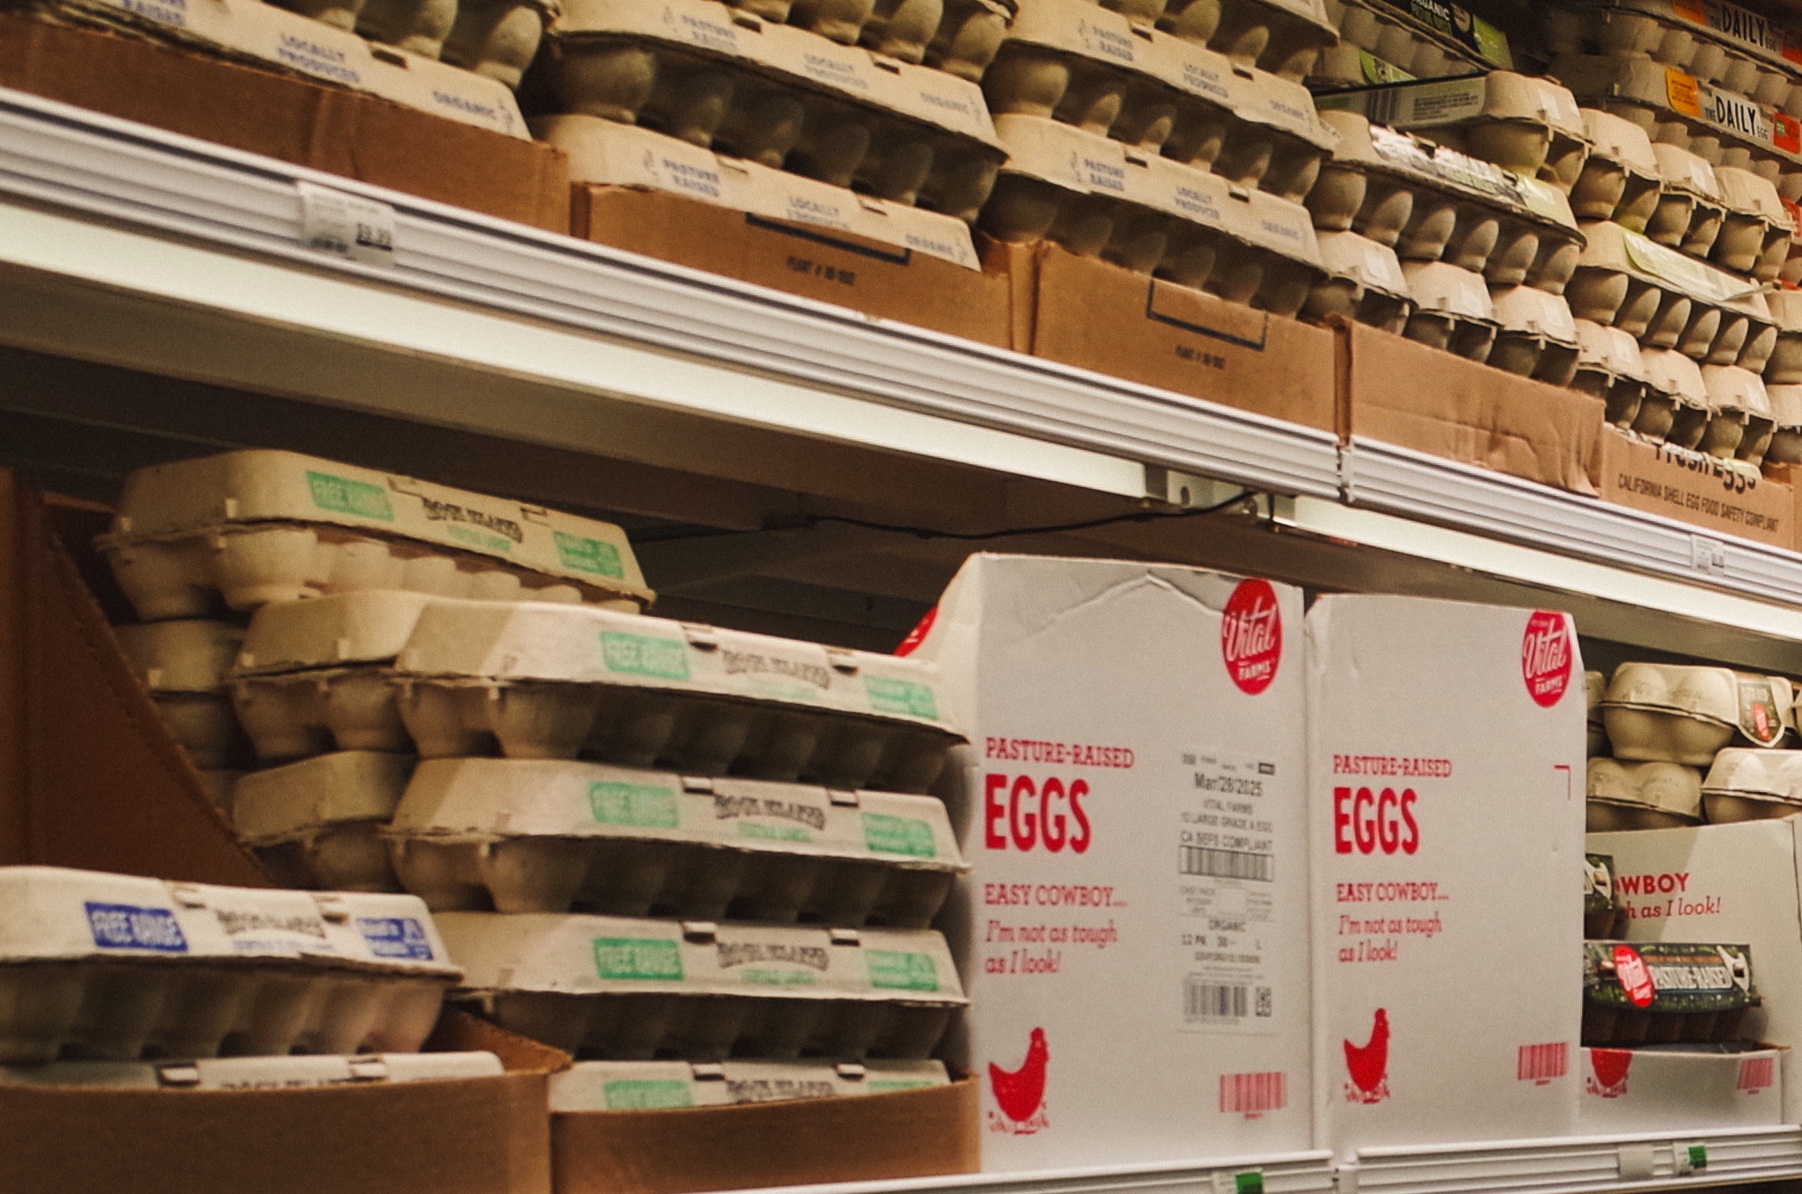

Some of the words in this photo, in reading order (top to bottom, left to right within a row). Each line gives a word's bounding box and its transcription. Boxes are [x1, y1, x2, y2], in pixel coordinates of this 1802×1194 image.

[1722, 4, 1766, 47] DAILY
[1705, 107, 1716, 122] THE
[1715, 95, 1756, 136] DAILY
[1618, 472, 1661, 498] CALIFORNIA
[1663, 485, 1685, 507] SHELL
[1686, 492, 1699, 511] EGG
[1701, 497, 1719, 517] FOOD
[1720, 503, 1744, 522] SAFETY
[1745, 510, 1779, 533] COMPLIANT
[1225, 597, 1276, 661] Vital
[1526, 620, 1568, 680] Vital
[1535, 676, 1563, 697] FARMS
[985, 736, 1135, 769] PASTURE-RAISED
[1333, 755, 1451, 778] PASTURE-RAISED
[984, 773, 1090, 854] EGGS
[1333, 786, 1419, 855] EGGS
[985, 883, 1034, 907] EASY
[1336, 882, 1371, 902] EASY
[1613, 872, 1690, 896] WBOY
[1642, 906, 1661, 918] as
[1666, 900, 1674, 917] I
[1678, 896, 1721, 917] look!
[985, 920, 1015, 944] I'm
[1017, 923, 1047, 944] not
[1049, 927, 1070, 944] as
[1071, 919, 1119, 949] tough
[1338, 914, 1361, 936] I'm
[1363, 915, 1384, 936] not
[1385, 919, 1402, 936] as
[1404, 914, 1442, 938] tough
[985, 956, 1006, 975] as
[1010, 951, 1019, 974] I
[1022, 949, 1061, 975] look!
[1338, 944, 1355, 962] as
[1357, 941, 1365, 961] I
[1367, 938, 1399, 962] look!
